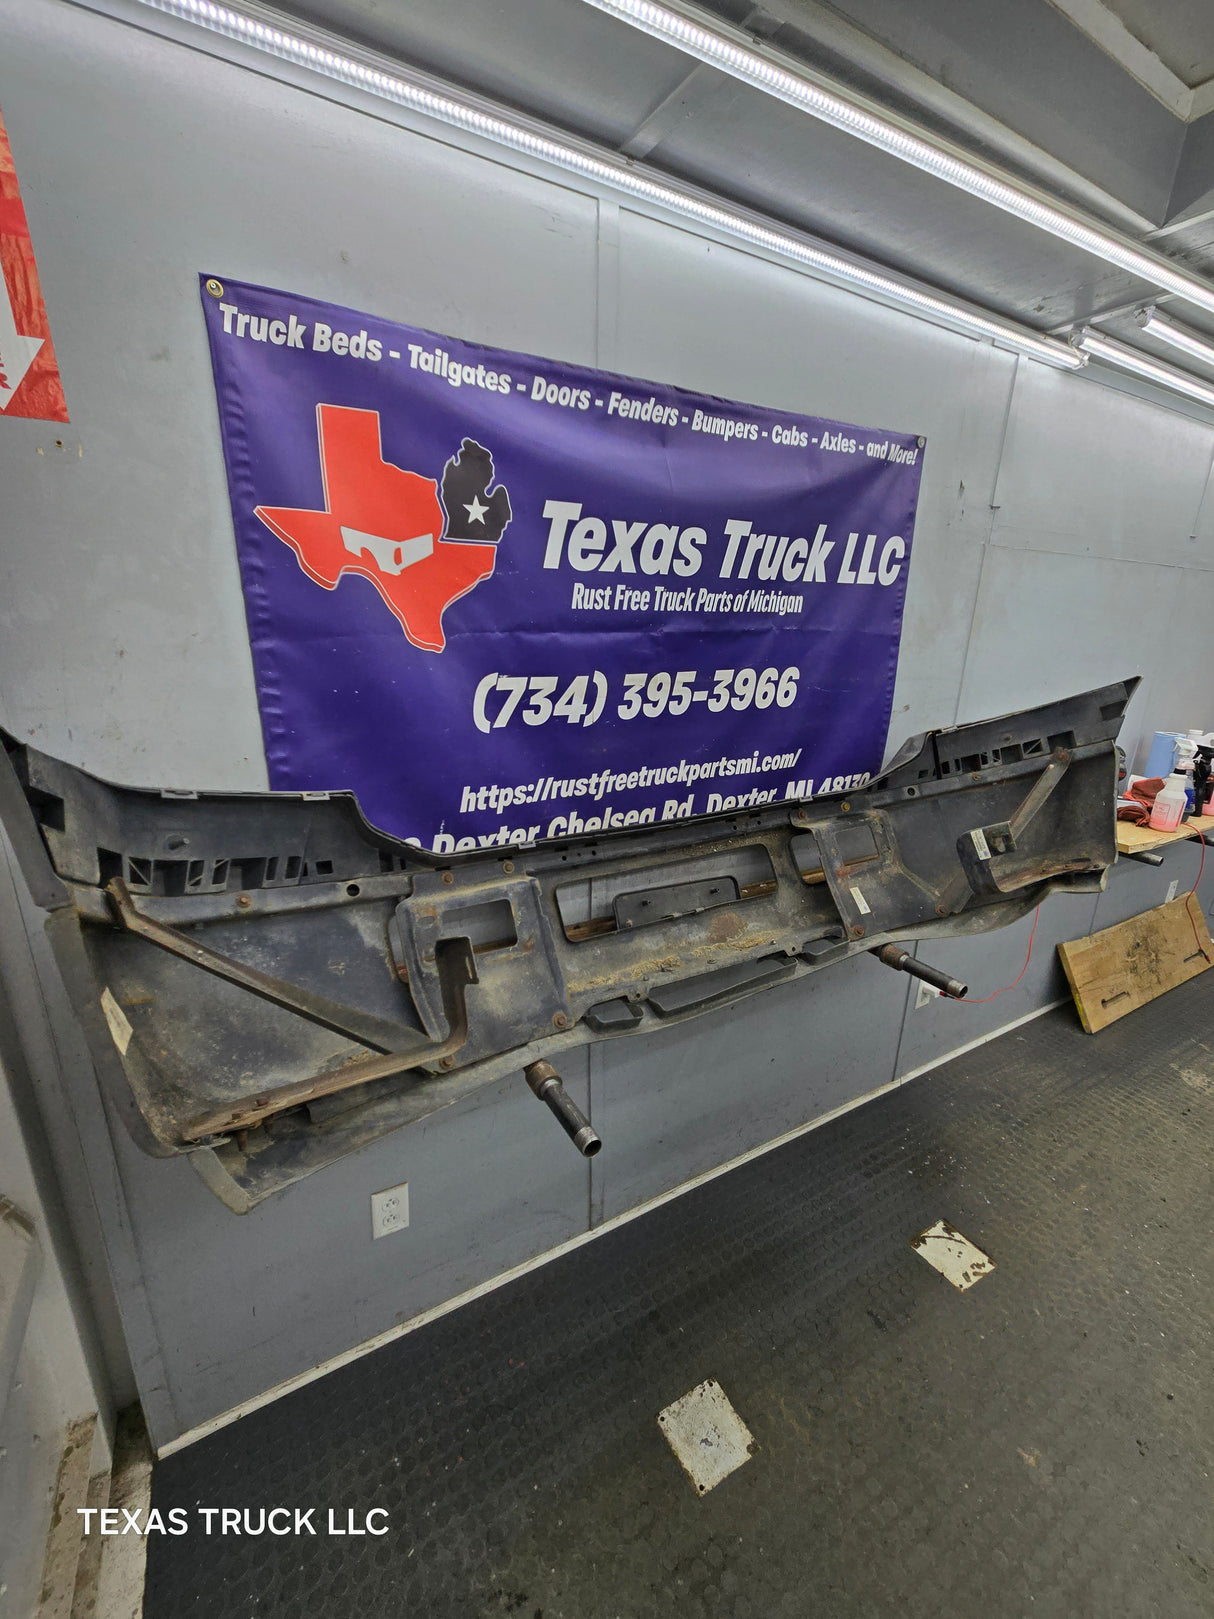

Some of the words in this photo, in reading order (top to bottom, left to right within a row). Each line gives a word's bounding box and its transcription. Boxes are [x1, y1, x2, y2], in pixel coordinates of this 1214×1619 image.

[218, 301, 307, 349] Truck
[313, 322, 383, 361] Beds
[408, 342, 513, 394] Tailgates
[531, 376, 591, 410] Doors
[608, 392, 678, 426] Fenders
[692, 410, 758, 441] Bumpers
[772, 425, 808, 447] Cabs
[820, 432, 856, 453] Axles
[866, 440, 888, 461] and
[887, 443, 918, 466] More!
[543, 500, 706, 576] Texas
[719, 519, 835, 582] Truck
[837, 533, 905, 585] LLC
[571, 582, 612, 611] Rust
[614, 585, 650, 611] Free
[654, 586, 696, 611] Truck
[695, 588, 732, 612] Parts
[732, 589, 750, 612] of
[749, 590, 804, 616] Michigan
[473, 671, 607, 733] (734)
[618, 667, 799, 719] 395-3966
[459, 748, 803, 814] https://rustfreetruckpartsmi.com/
[707, 788, 777, 813] Dexter
